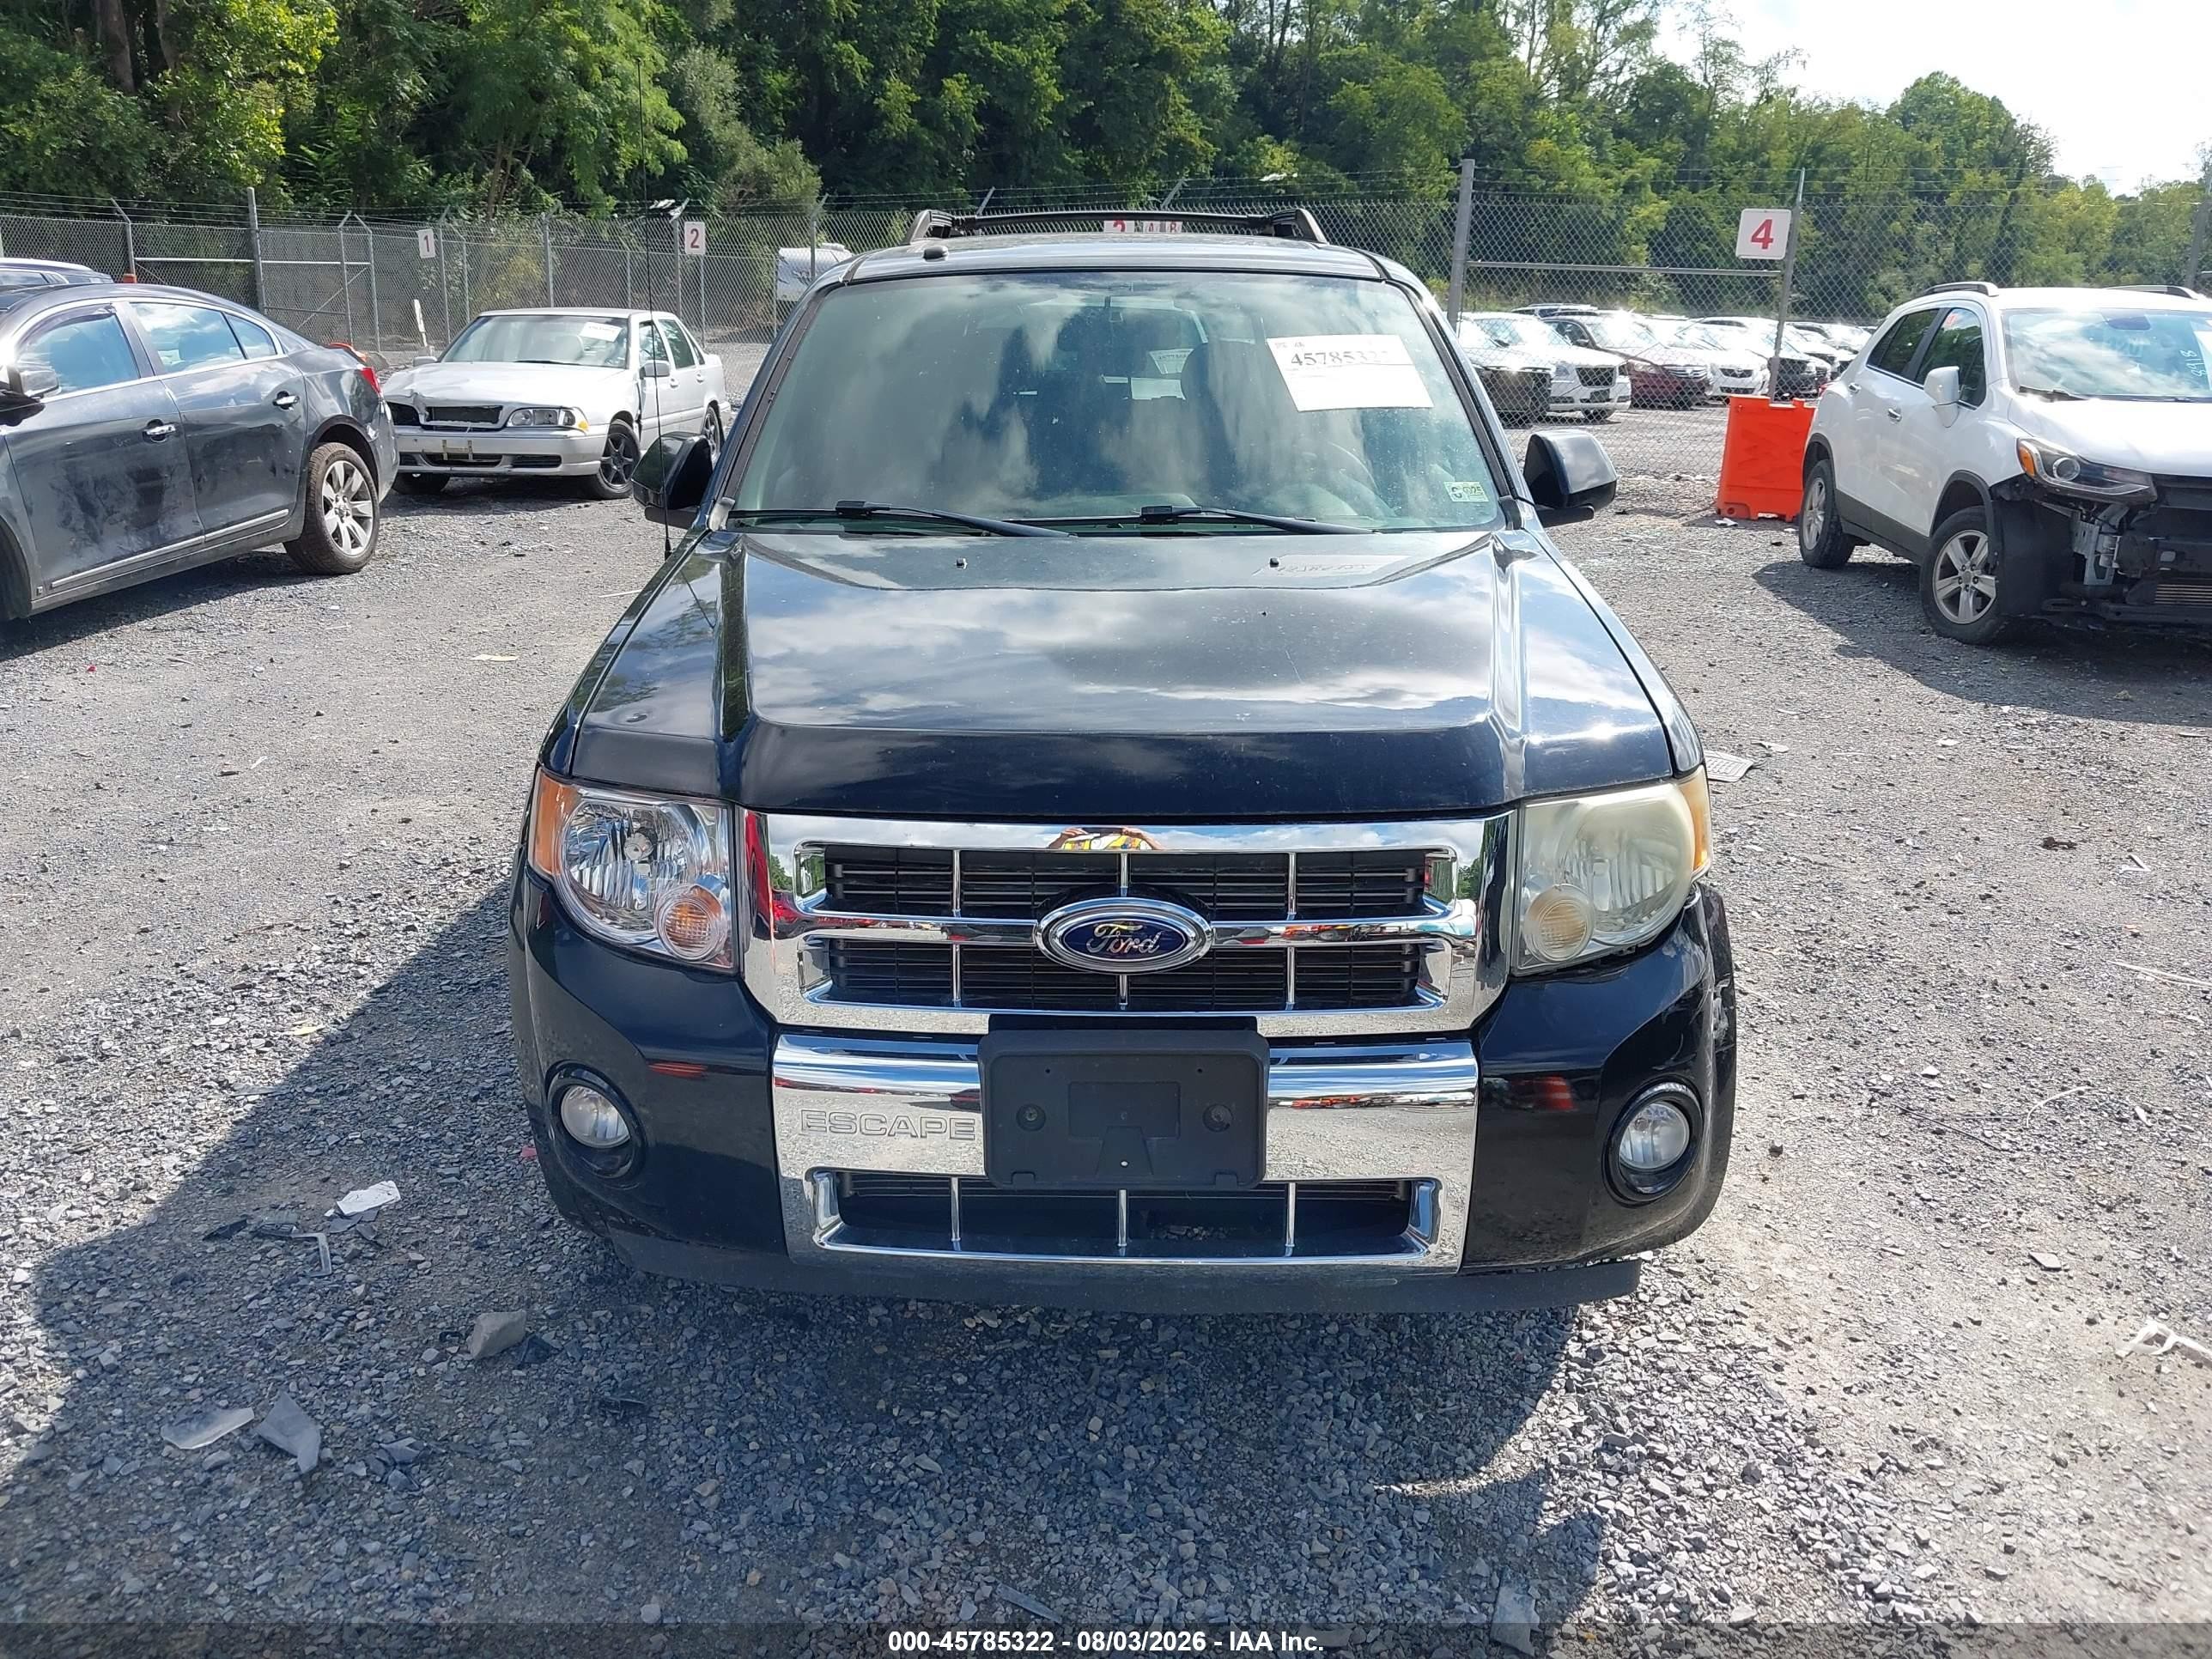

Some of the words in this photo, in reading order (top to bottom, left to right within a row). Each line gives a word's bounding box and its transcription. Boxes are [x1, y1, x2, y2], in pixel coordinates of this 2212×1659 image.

[423, 234, 430, 252] 1
[690, 228, 701, 249] 2
[1750, 218, 1774, 250] 4
[1085, 922, 1164, 954] Ford
[799, 1109, 977, 1141] ESCAPE
